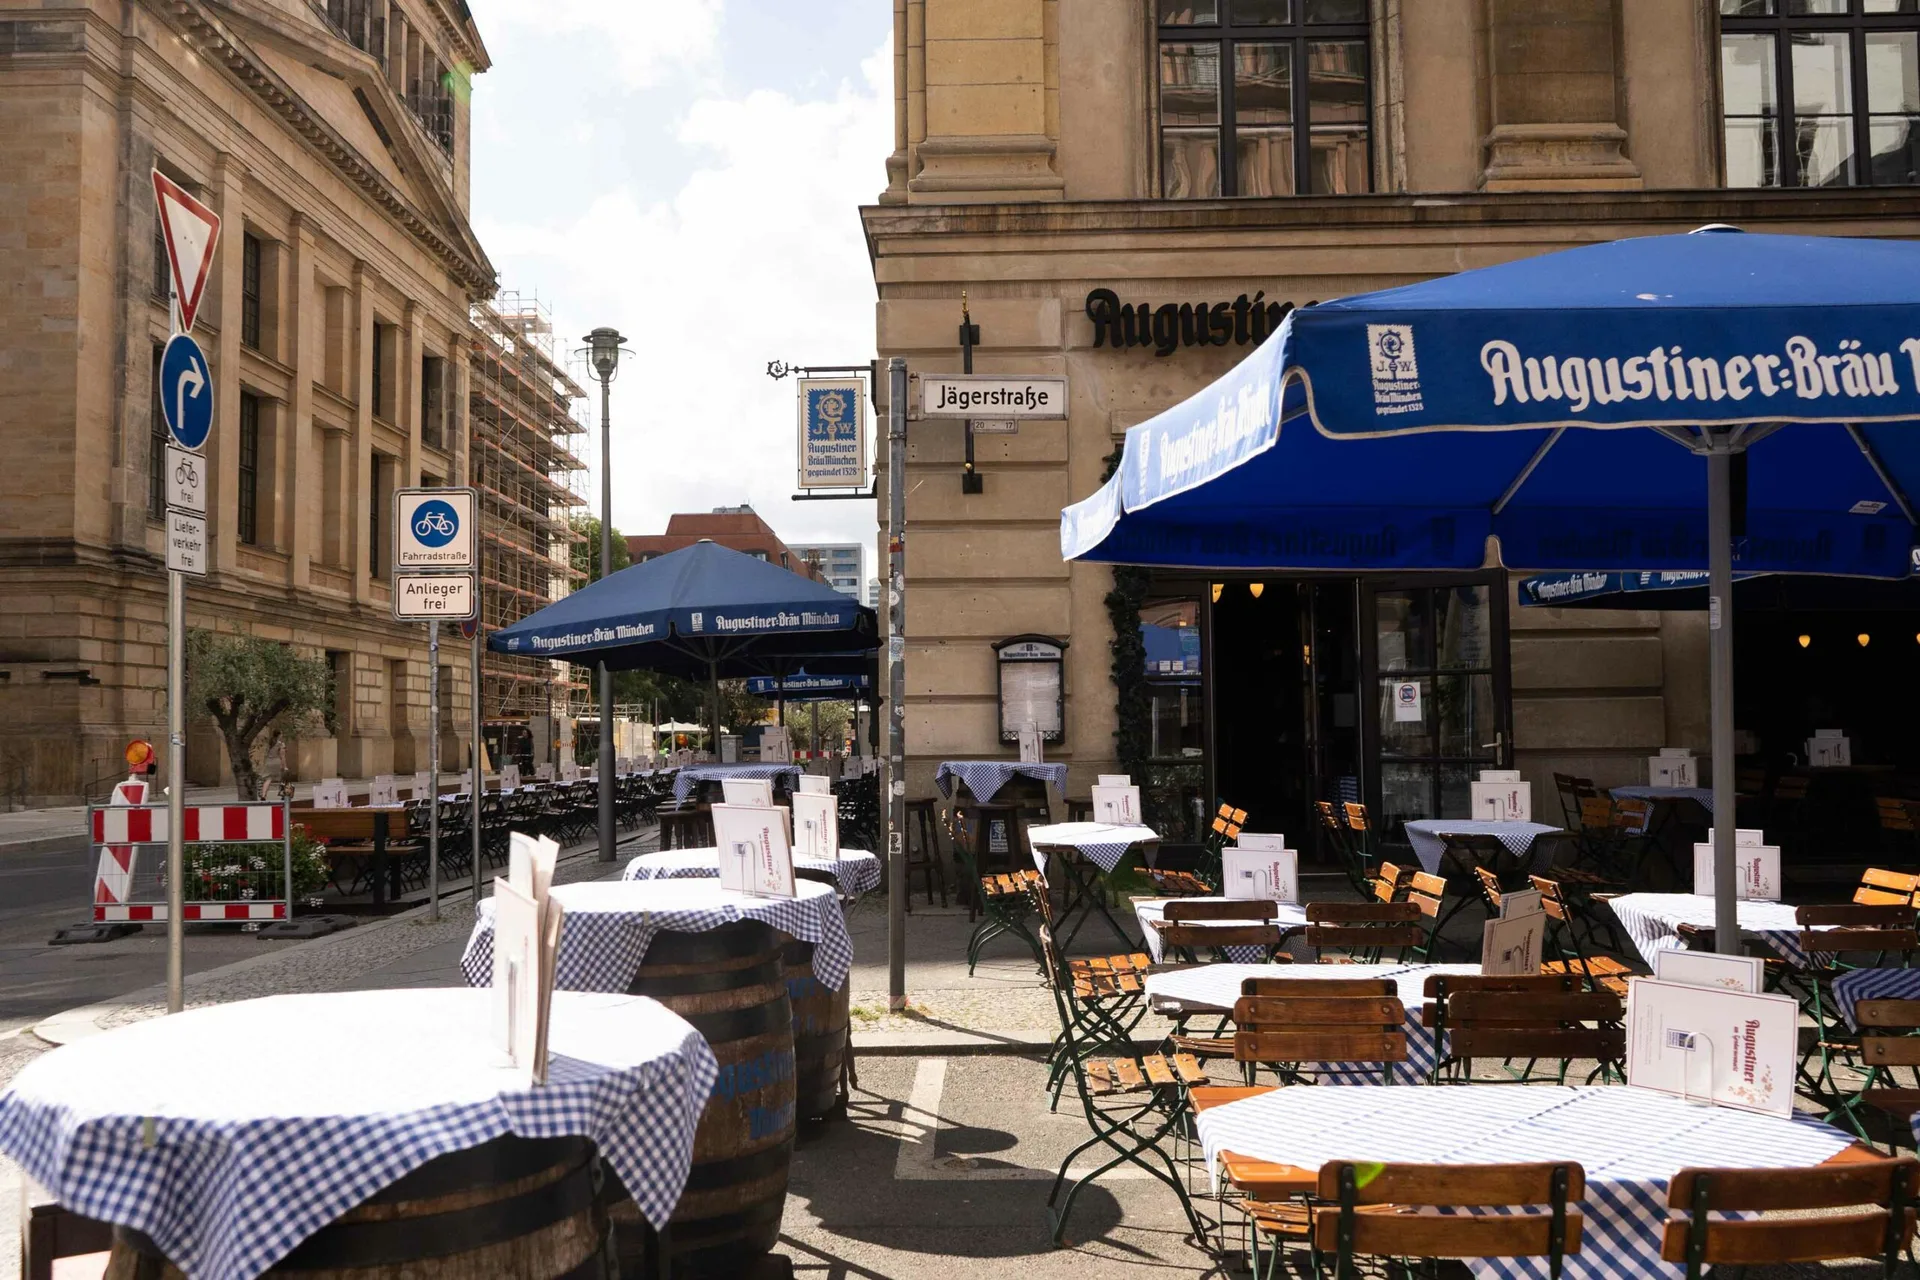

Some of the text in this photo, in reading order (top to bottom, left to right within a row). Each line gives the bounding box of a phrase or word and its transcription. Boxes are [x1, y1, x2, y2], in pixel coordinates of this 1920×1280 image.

[937, 385, 1048, 410] Jägerstraße
[181, 489, 194, 503] frei
[174, 518, 199, 534] Liefer-
[173, 538, 202, 552] verkehr
[181, 553, 194, 567] frei
[403, 552, 467, 561] Fahrradstraße
[406, 583, 463, 597] Anlieger
[423, 598, 446, 610] frei
[801, 612, 840, 626] München
[616, 623, 654, 639] München
[1743, 1019, 1760, 1085] Augustiner
